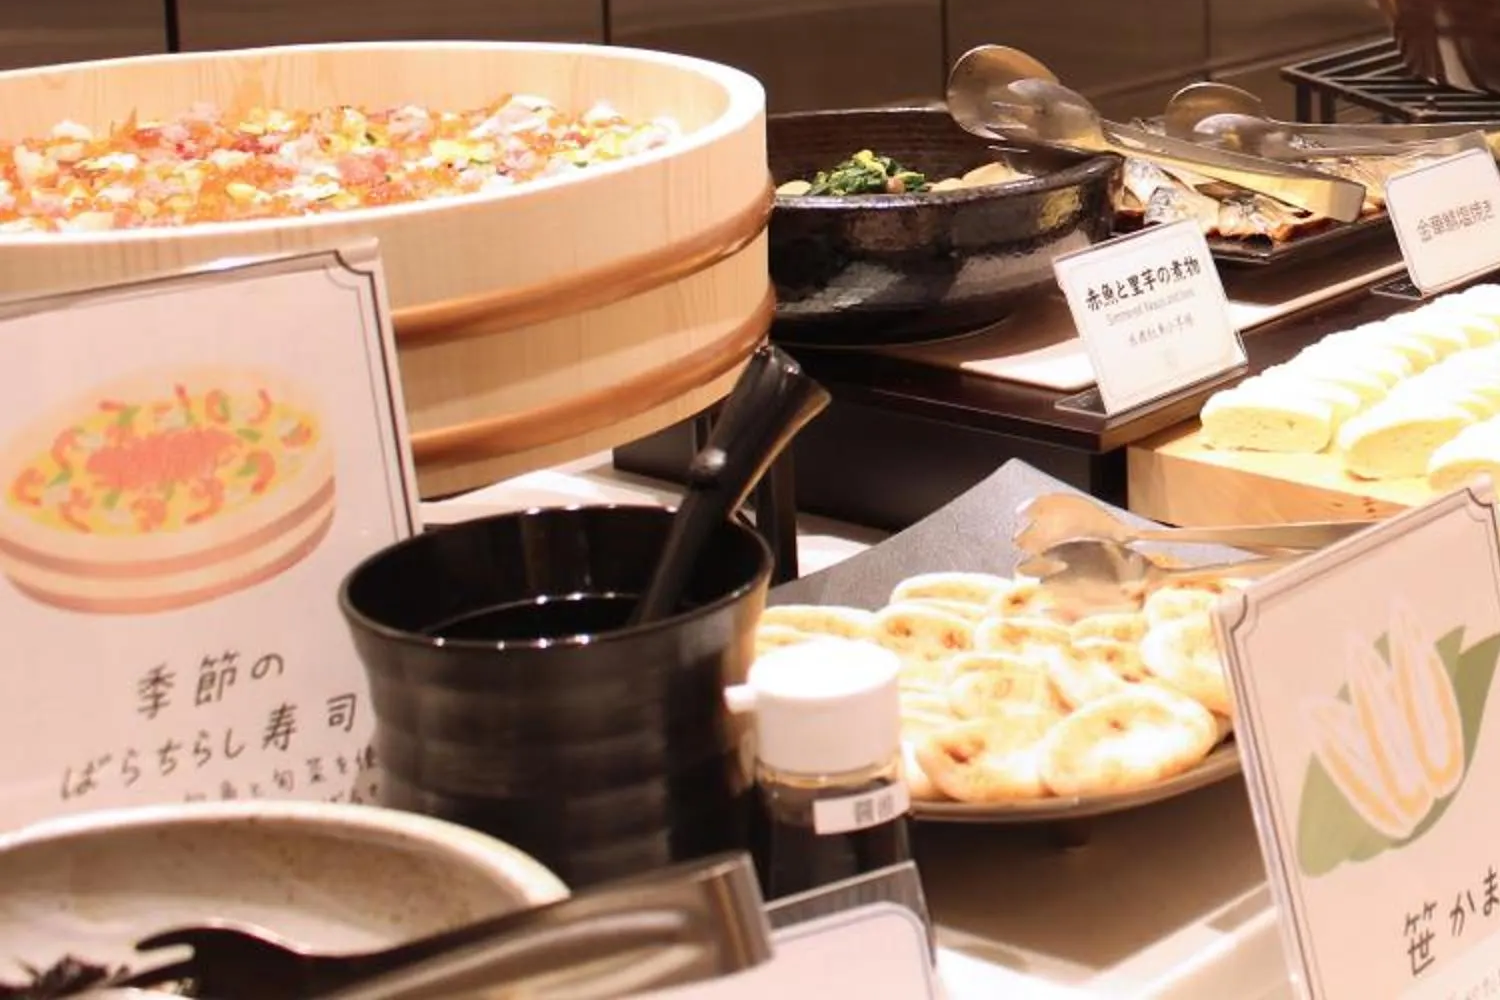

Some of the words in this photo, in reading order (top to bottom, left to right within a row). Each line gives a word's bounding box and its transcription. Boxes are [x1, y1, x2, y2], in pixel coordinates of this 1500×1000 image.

[1085, 256, 1201, 312] 赤魚と里芋の煮物
[137, 651, 284, 719] 季節の
[60, 693, 358, 802] ばらちらし寿司
[1403, 866, 1500, 976] 笹かま
